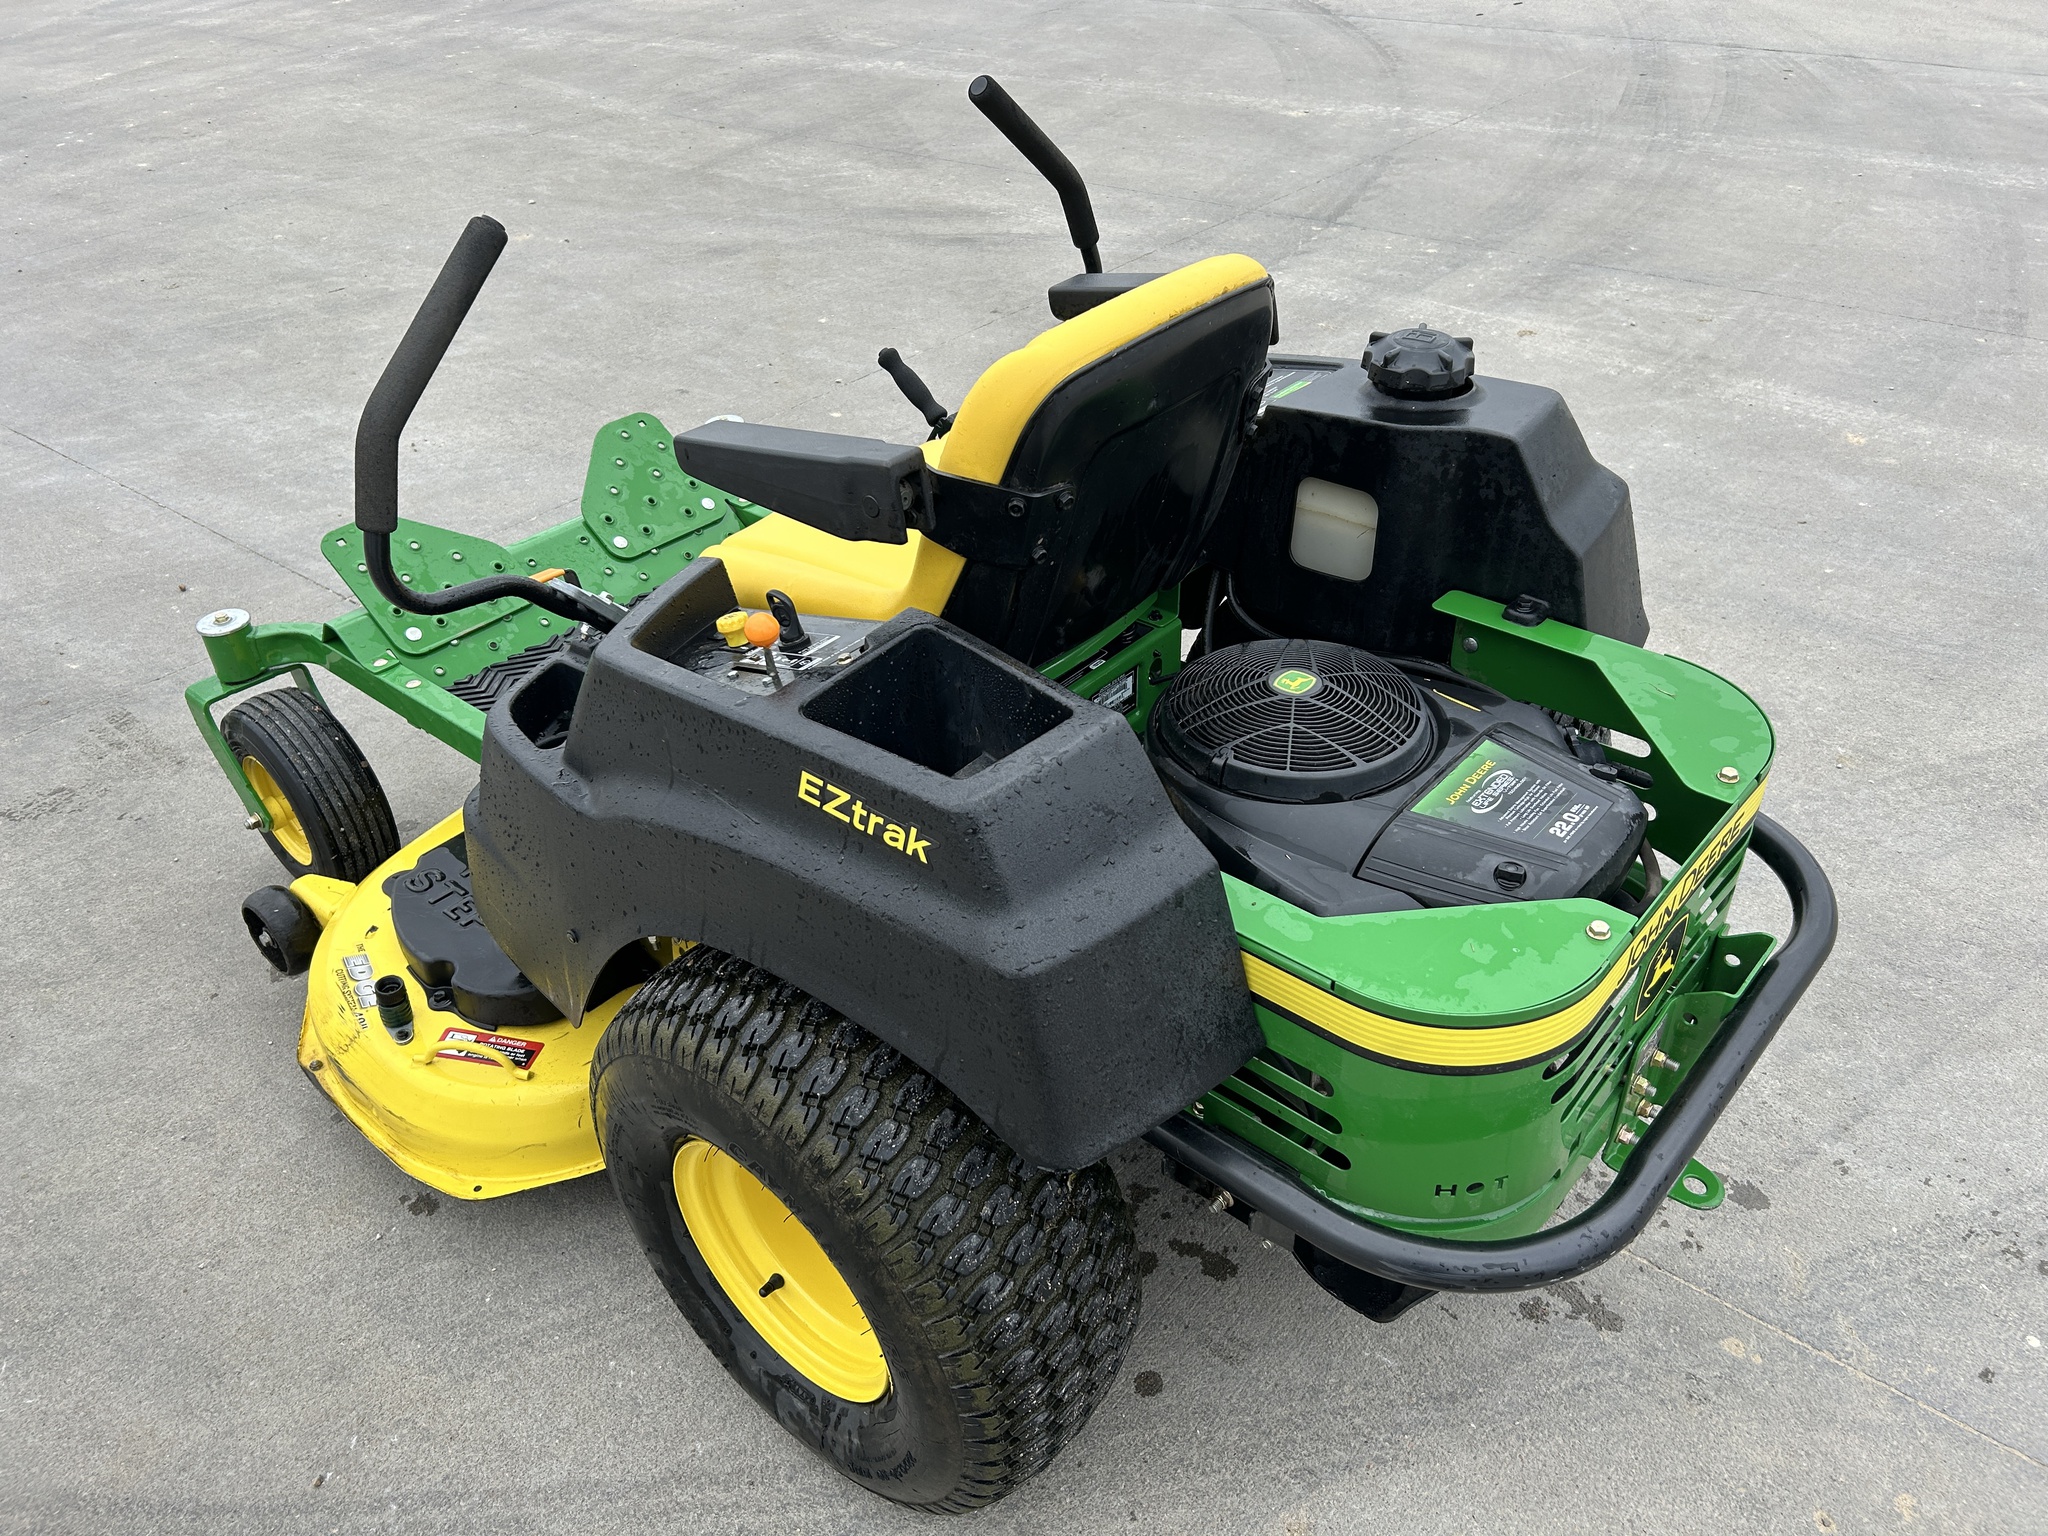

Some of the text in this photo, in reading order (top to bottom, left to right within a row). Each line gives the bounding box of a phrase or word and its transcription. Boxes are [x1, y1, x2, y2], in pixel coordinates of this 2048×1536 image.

[1446, 783, 1471, 805] JOHN
[1465, 760, 1496, 785] DEERE
[1471, 772, 1509, 807] EXTENDED
[1479, 797, 1494, 810] LIFE
[798, 771, 934, 864] EZtrak
[1549, 812, 1580, 838] 22.0
[1616, 812, 1745, 990] JOHN DEERE
[355, 942, 365, 953] THE
[342, 953, 378, 1009] EDGE
[496, 1037, 527, 1048] DANGER
[506, 1046, 526, 1054] BLADE
[1435, 1175, 1510, 1198] HOT
